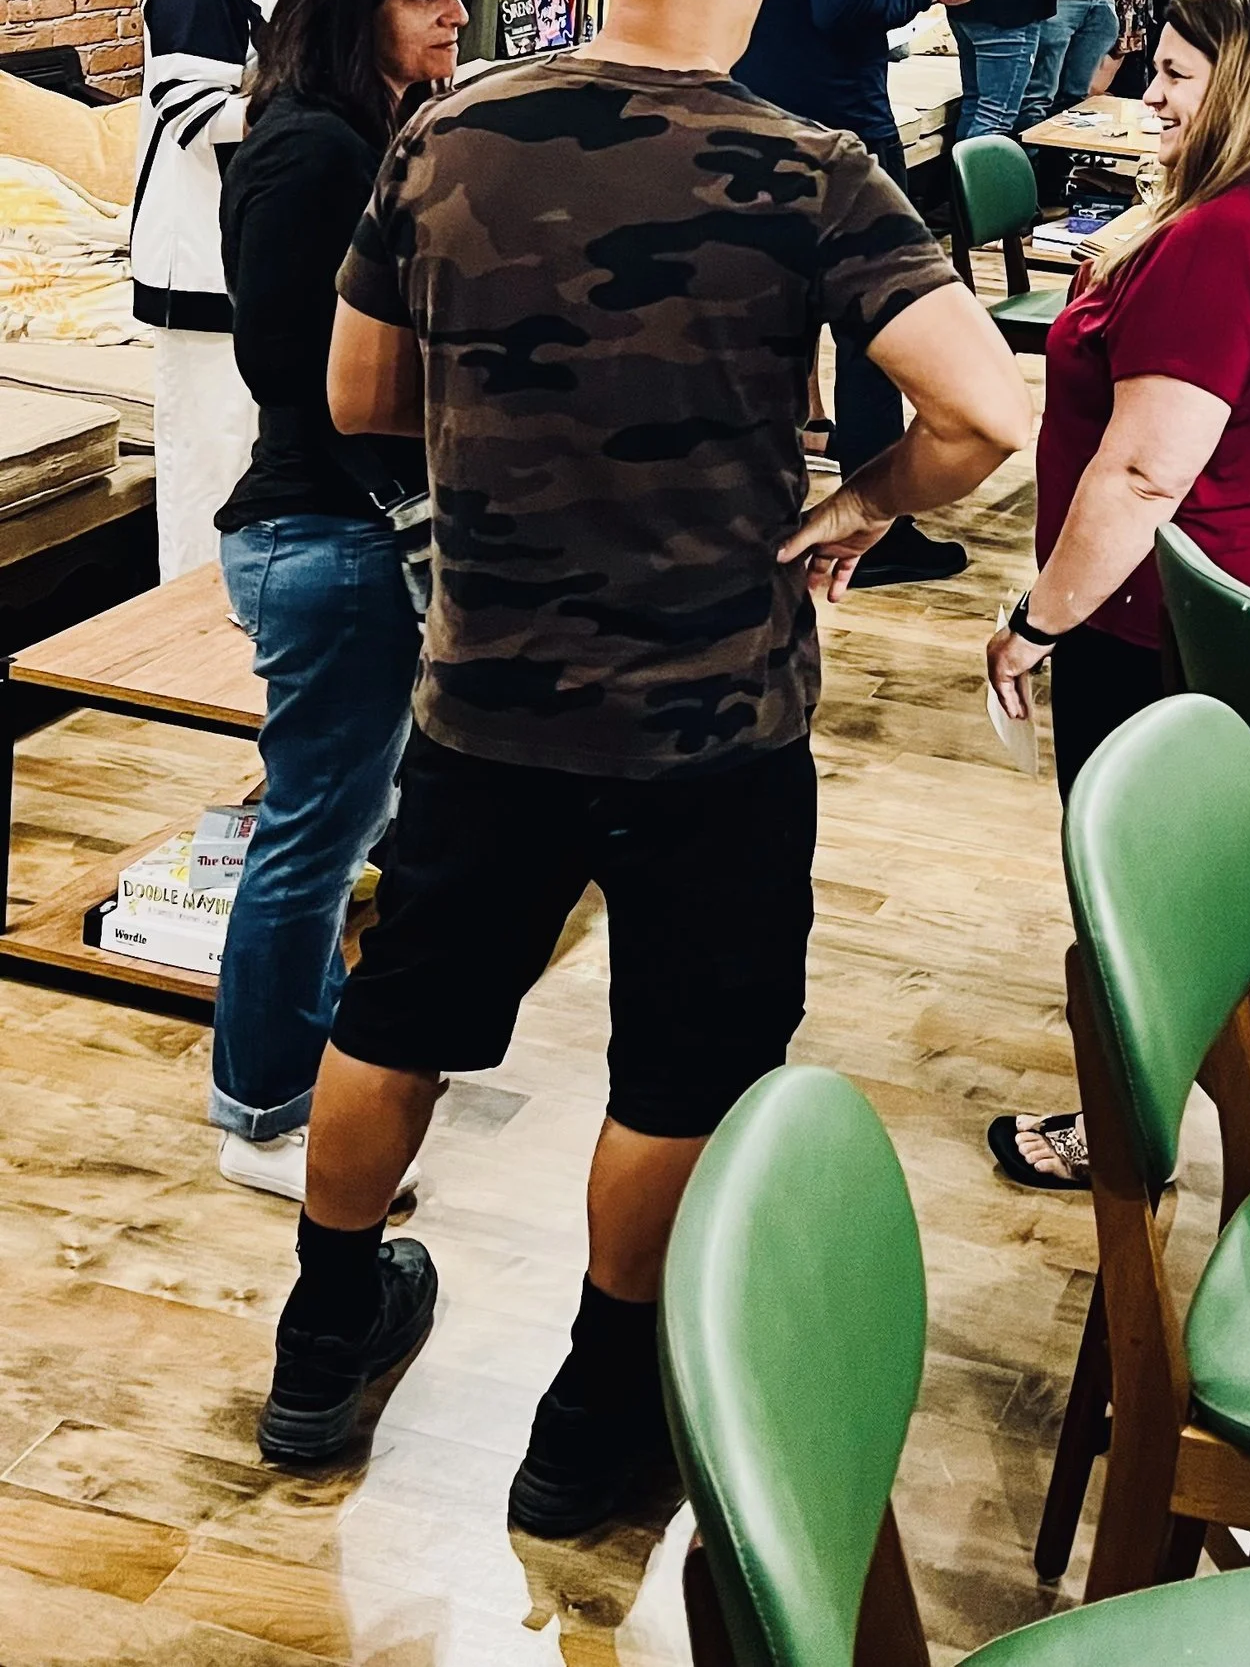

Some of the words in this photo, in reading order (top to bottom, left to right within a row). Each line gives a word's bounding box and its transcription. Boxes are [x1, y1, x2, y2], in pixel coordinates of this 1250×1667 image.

[197, 855, 219, 866] The
[221, 855, 244, 866] Cou
[123, 880, 179, 905] DOODLE
[182, 891, 234, 916] MAYHE
[114, 927, 148, 945] Wordle
